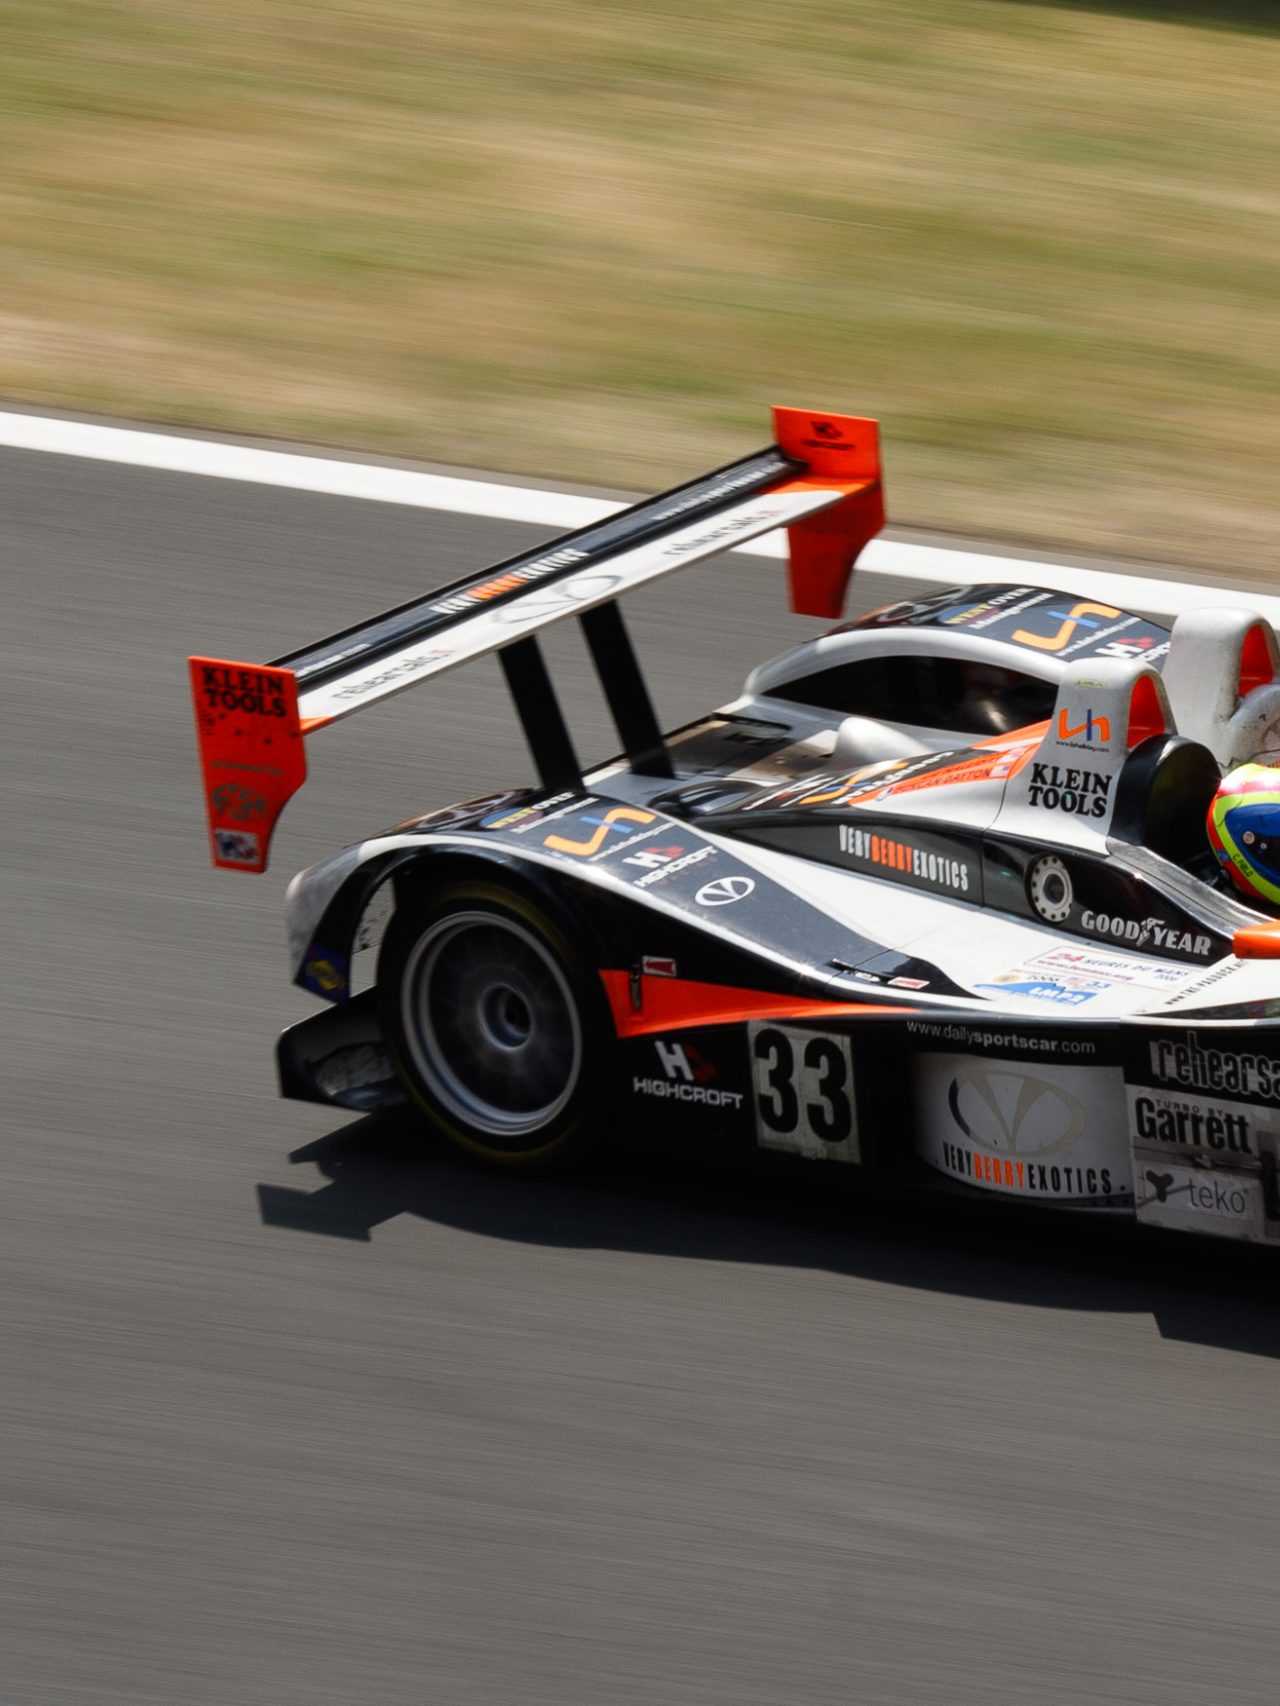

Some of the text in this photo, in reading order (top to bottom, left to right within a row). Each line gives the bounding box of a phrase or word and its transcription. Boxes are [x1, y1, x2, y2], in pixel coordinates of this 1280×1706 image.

[203, 667, 284, 695] KLEIN
[204, 688, 287, 718] TOOLS
[1030, 763, 1112, 796] KLEIN
[1028, 785, 1108, 818] TOOLS
[1081, 909, 1212, 956] GOODYEAR
[906, 1020, 1096, 1055] www.dailysportscar.com
[633, 1076, 743, 1110] HIGHCROFT
[754, 1028, 853, 1143] 33
[1156, 1099, 1224, 1118] TURBO BY
[1134, 1098, 1253, 1154] Garrett
